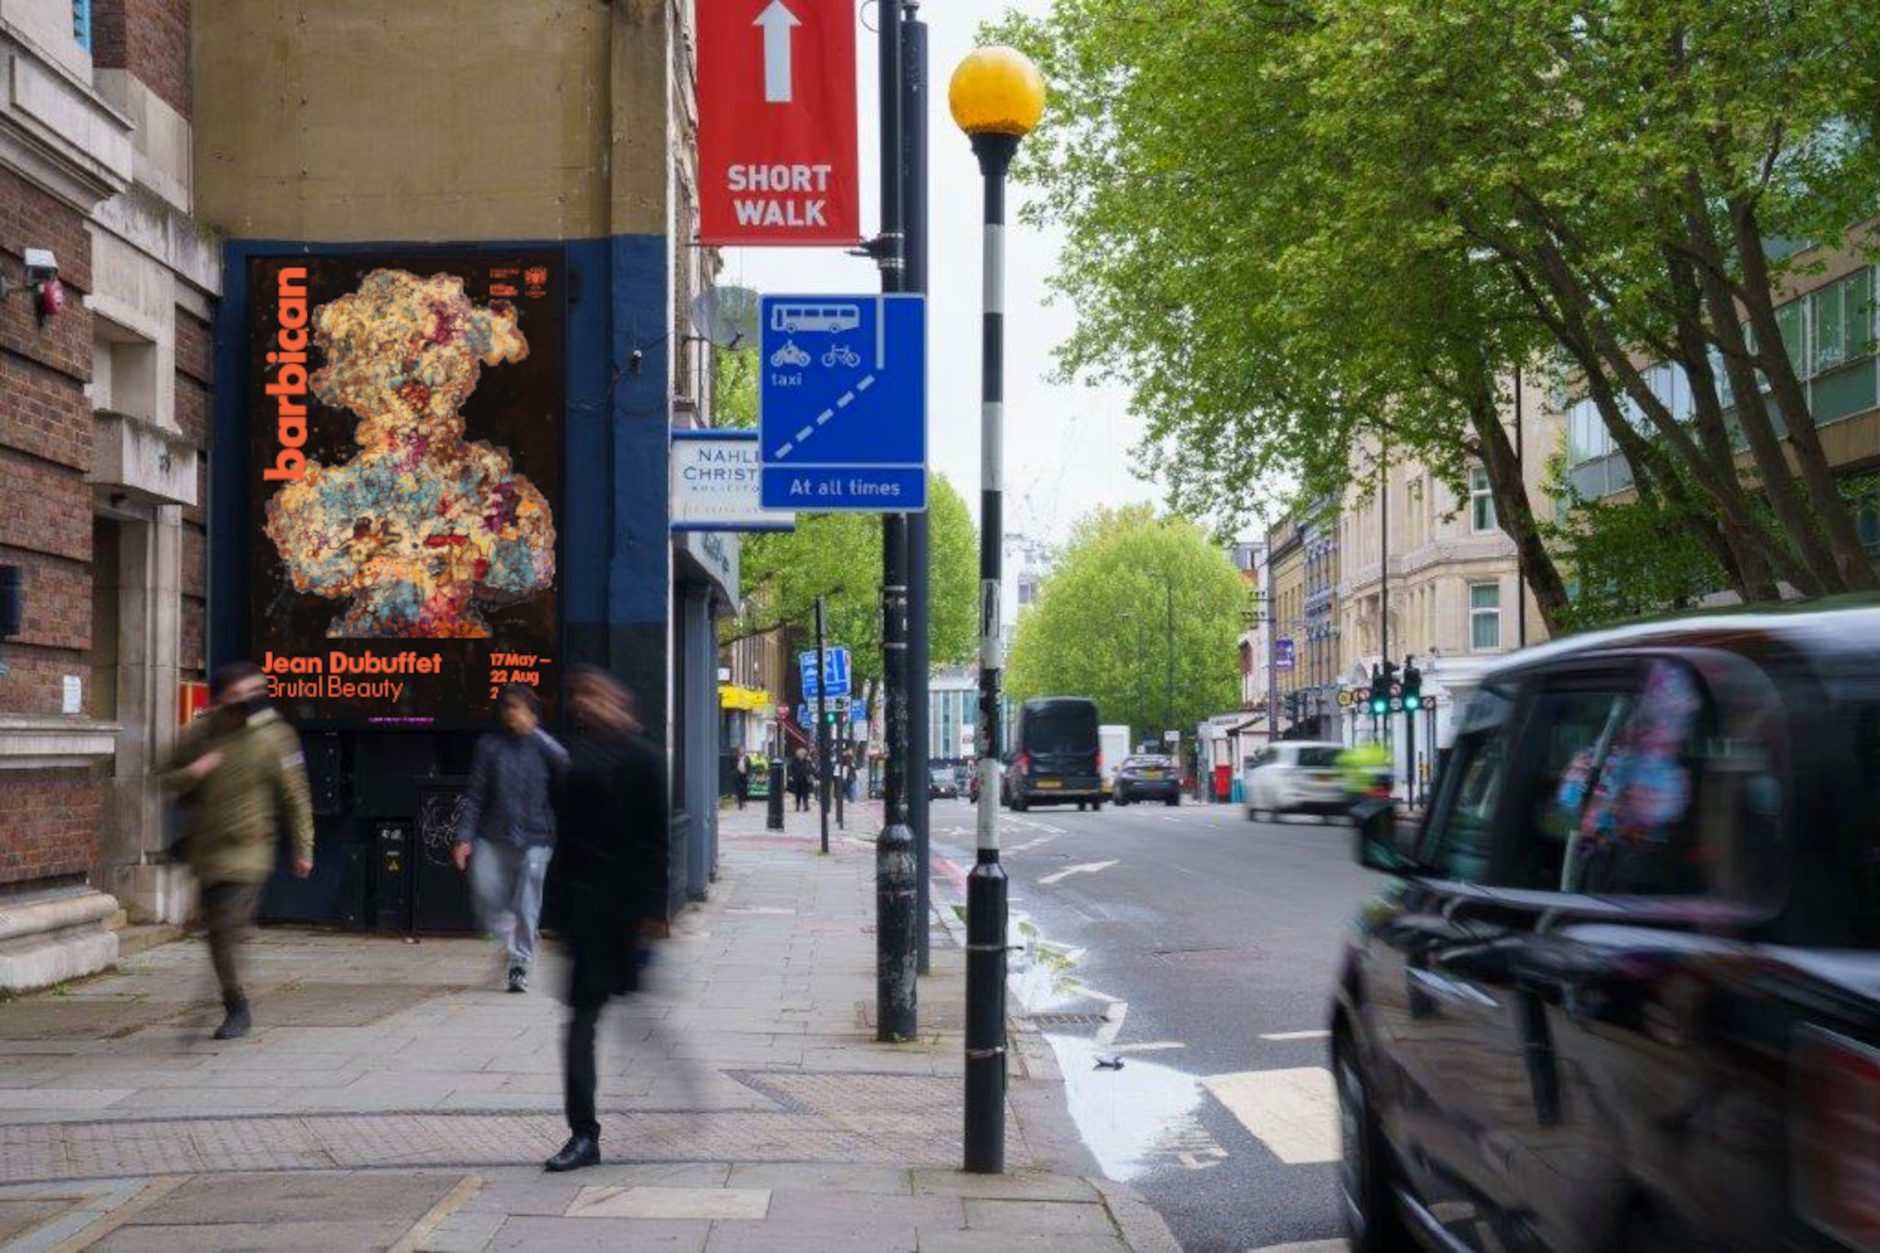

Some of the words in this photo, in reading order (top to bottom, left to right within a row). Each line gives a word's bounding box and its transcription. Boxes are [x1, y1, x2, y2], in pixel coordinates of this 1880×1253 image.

[727, 164, 832, 192] SHORT
[733, 199, 828, 226] WALK
[263, 267, 308, 480] barbican
[771, 371, 802, 387] taxi
[790, 479, 812, 496] At
[818, 479, 842, 496] all
[848, 479, 900, 496] times
[260, 650, 323, 674] Jean
[329, 650, 442, 674] Dubuffet
[265, 675, 323, 698] Brutal
[328, 675, 403, 702] Beauty
[490, 670, 508, 683] 22
[510, 670, 540, 687] Aug
